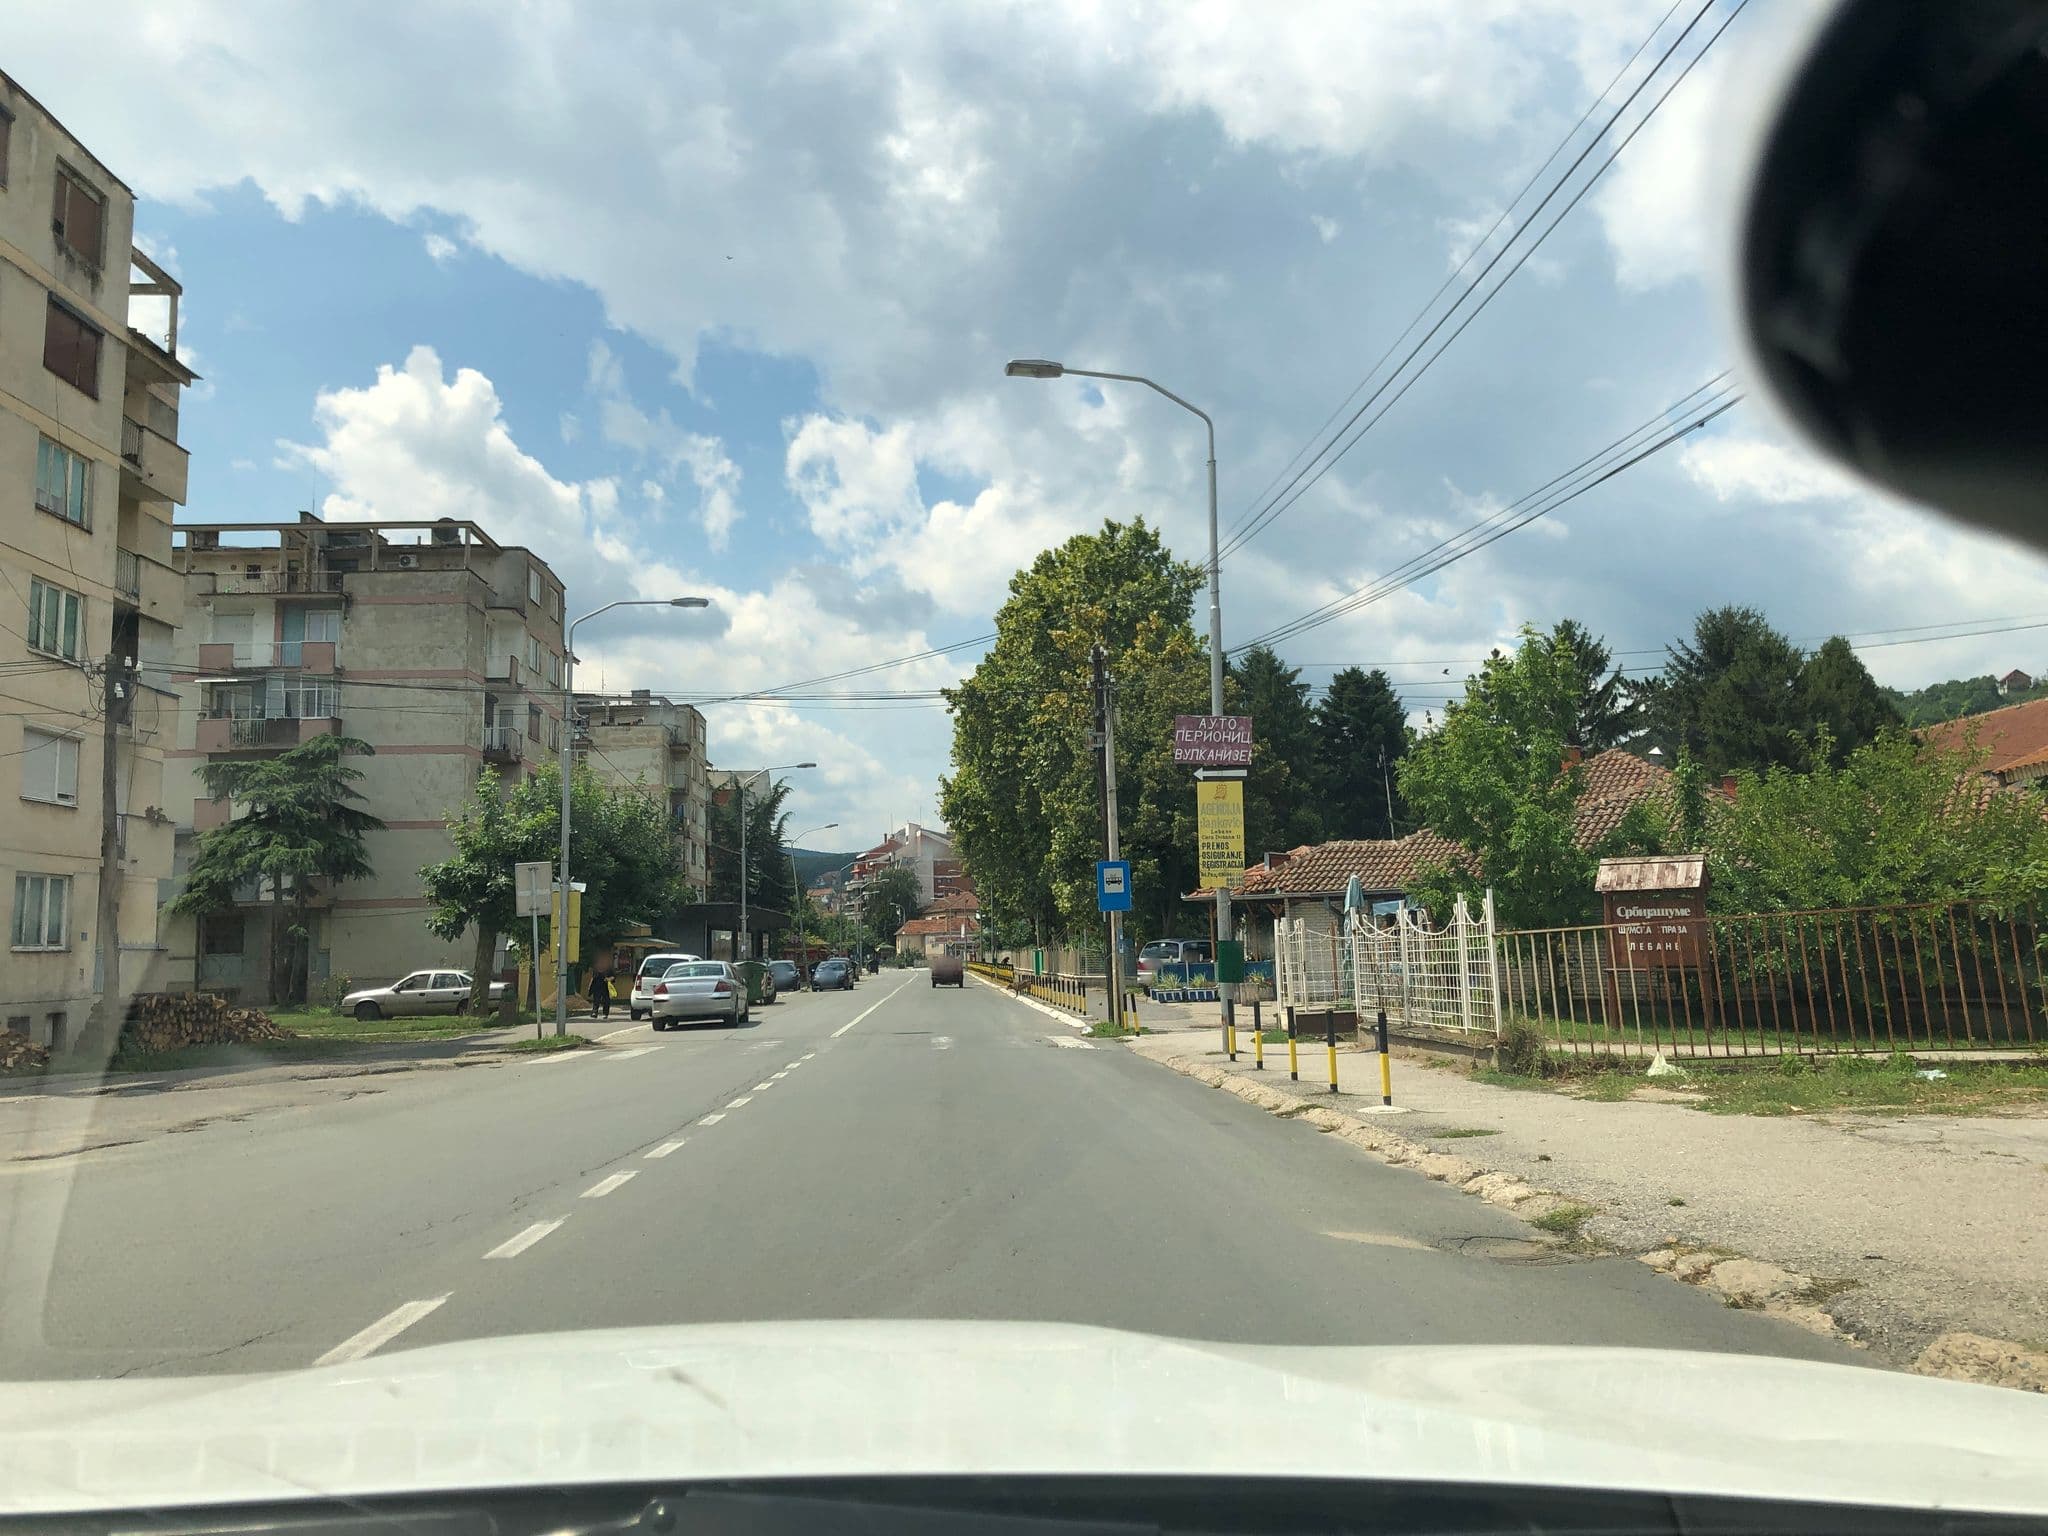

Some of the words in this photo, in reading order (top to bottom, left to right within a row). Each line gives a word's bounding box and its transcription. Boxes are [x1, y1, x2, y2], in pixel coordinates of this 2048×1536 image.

[1199, 718, 1237, 730] АУТО
[1201, 841, 1230, 850] PRENOS
[1616, 905, 1692, 919] Србијашуме
[1630, 942, 1680, 951] ЛЕБАНЕ
